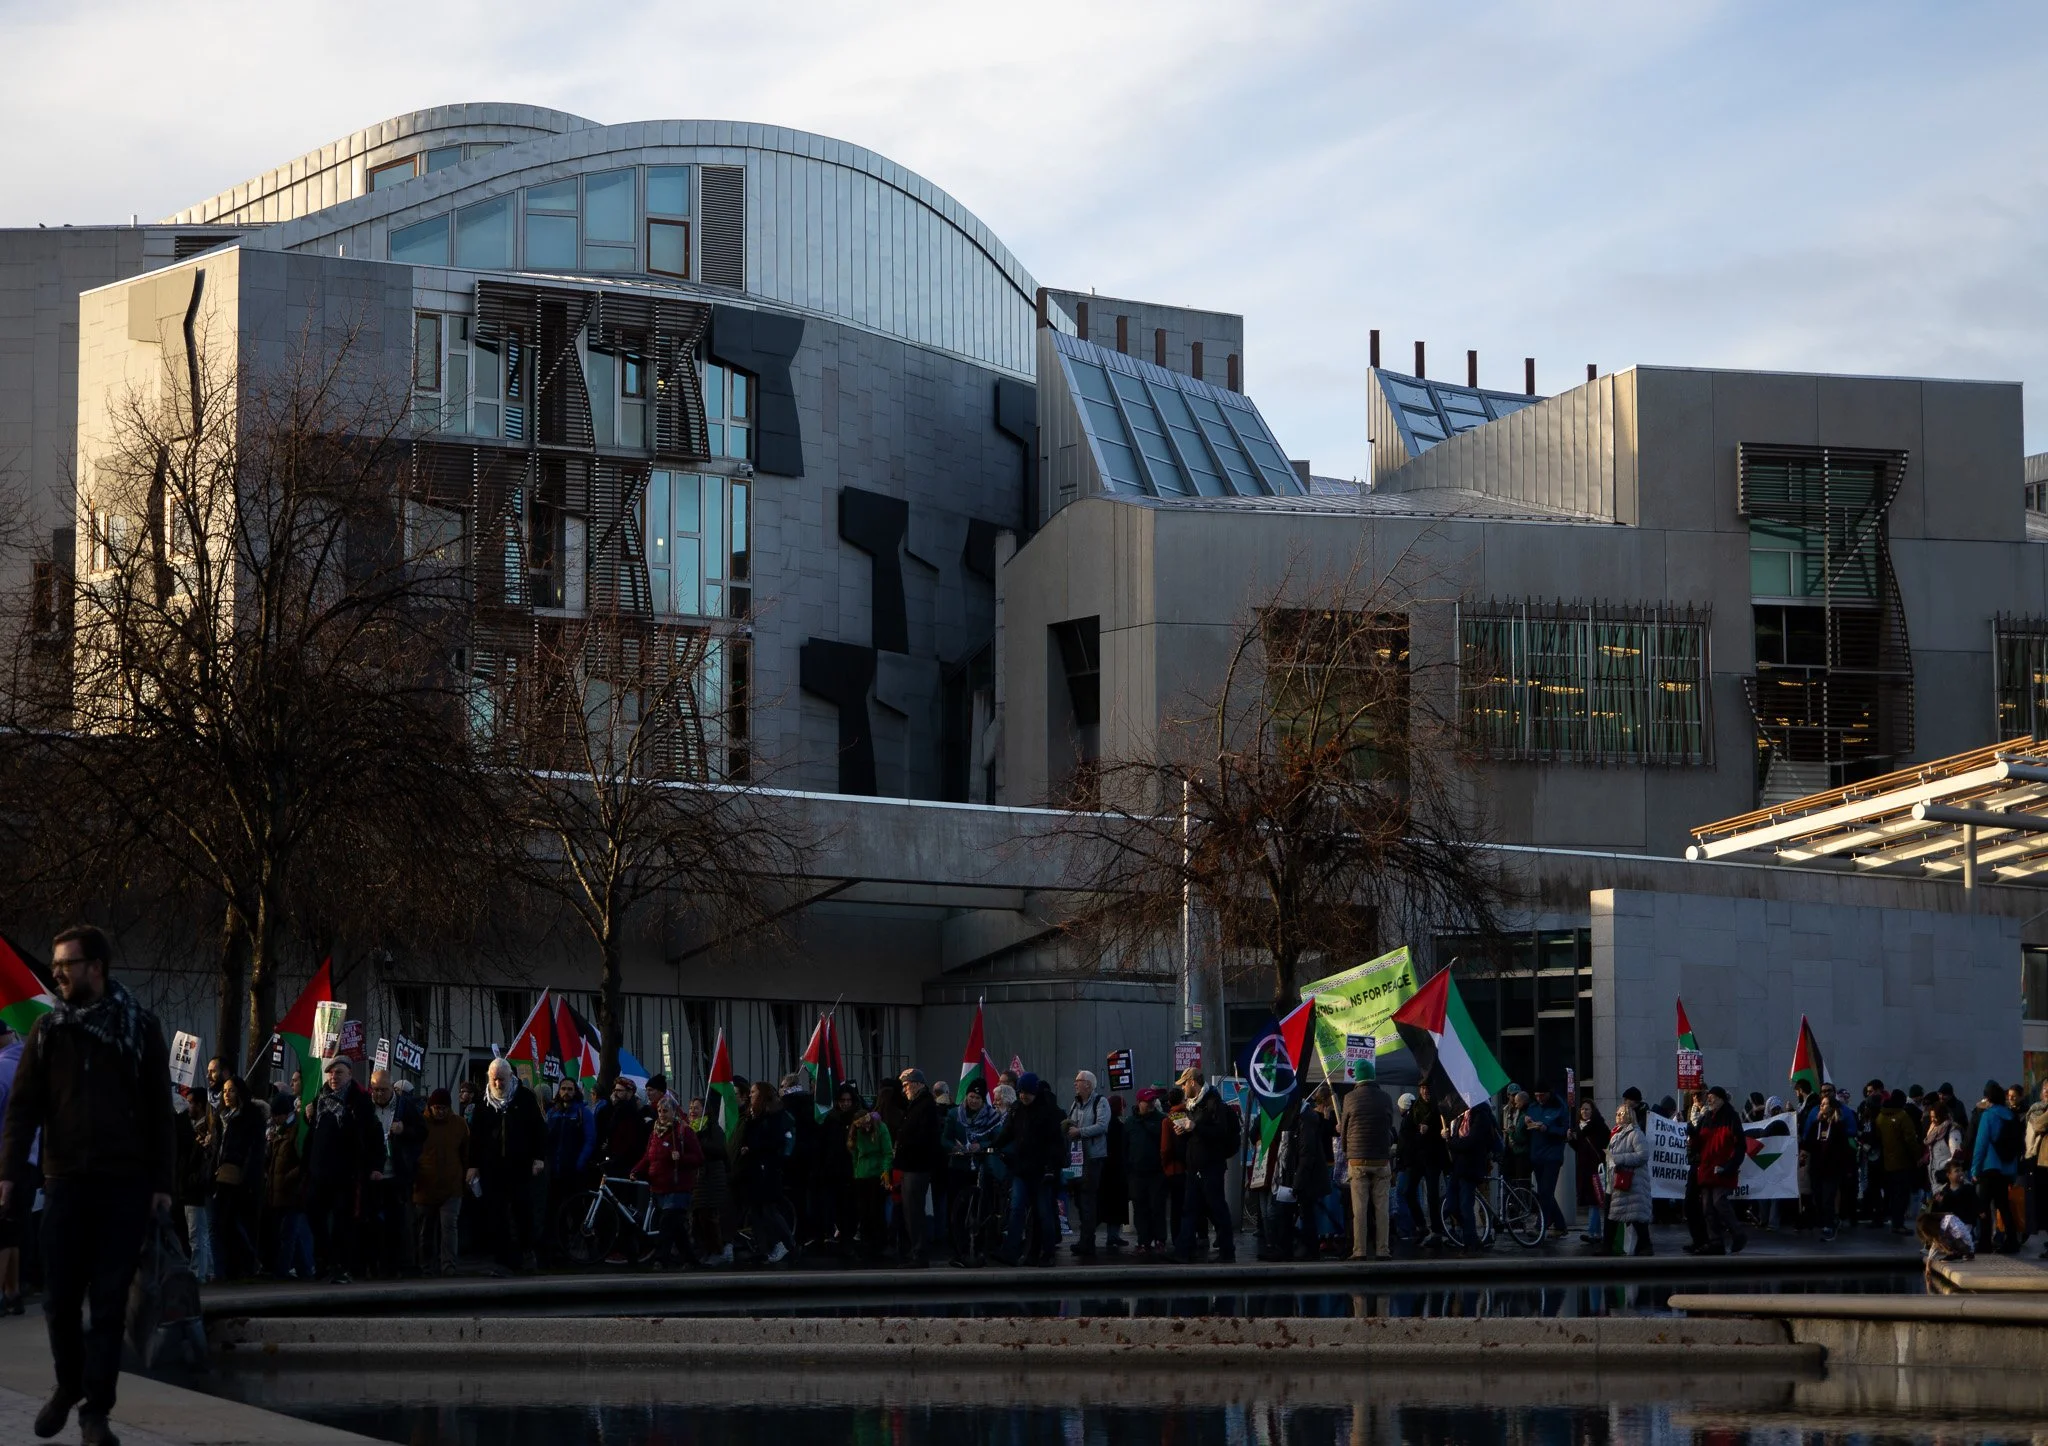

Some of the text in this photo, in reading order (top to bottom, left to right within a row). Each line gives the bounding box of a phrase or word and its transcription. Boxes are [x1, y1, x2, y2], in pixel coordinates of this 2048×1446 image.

[1363, 985, 1381, 1003] FOR
[1382, 973, 1412, 996] PEACE
[175, 1053, 192, 1064] BAN
[396, 1042, 421, 1071] GAZA
[544, 1061, 560, 1077] GAZA
[1656, 1120, 1676, 1135] FROM
[1655, 1134, 1666, 1148] TO
[1652, 1167, 1688, 1181] WARFAR
